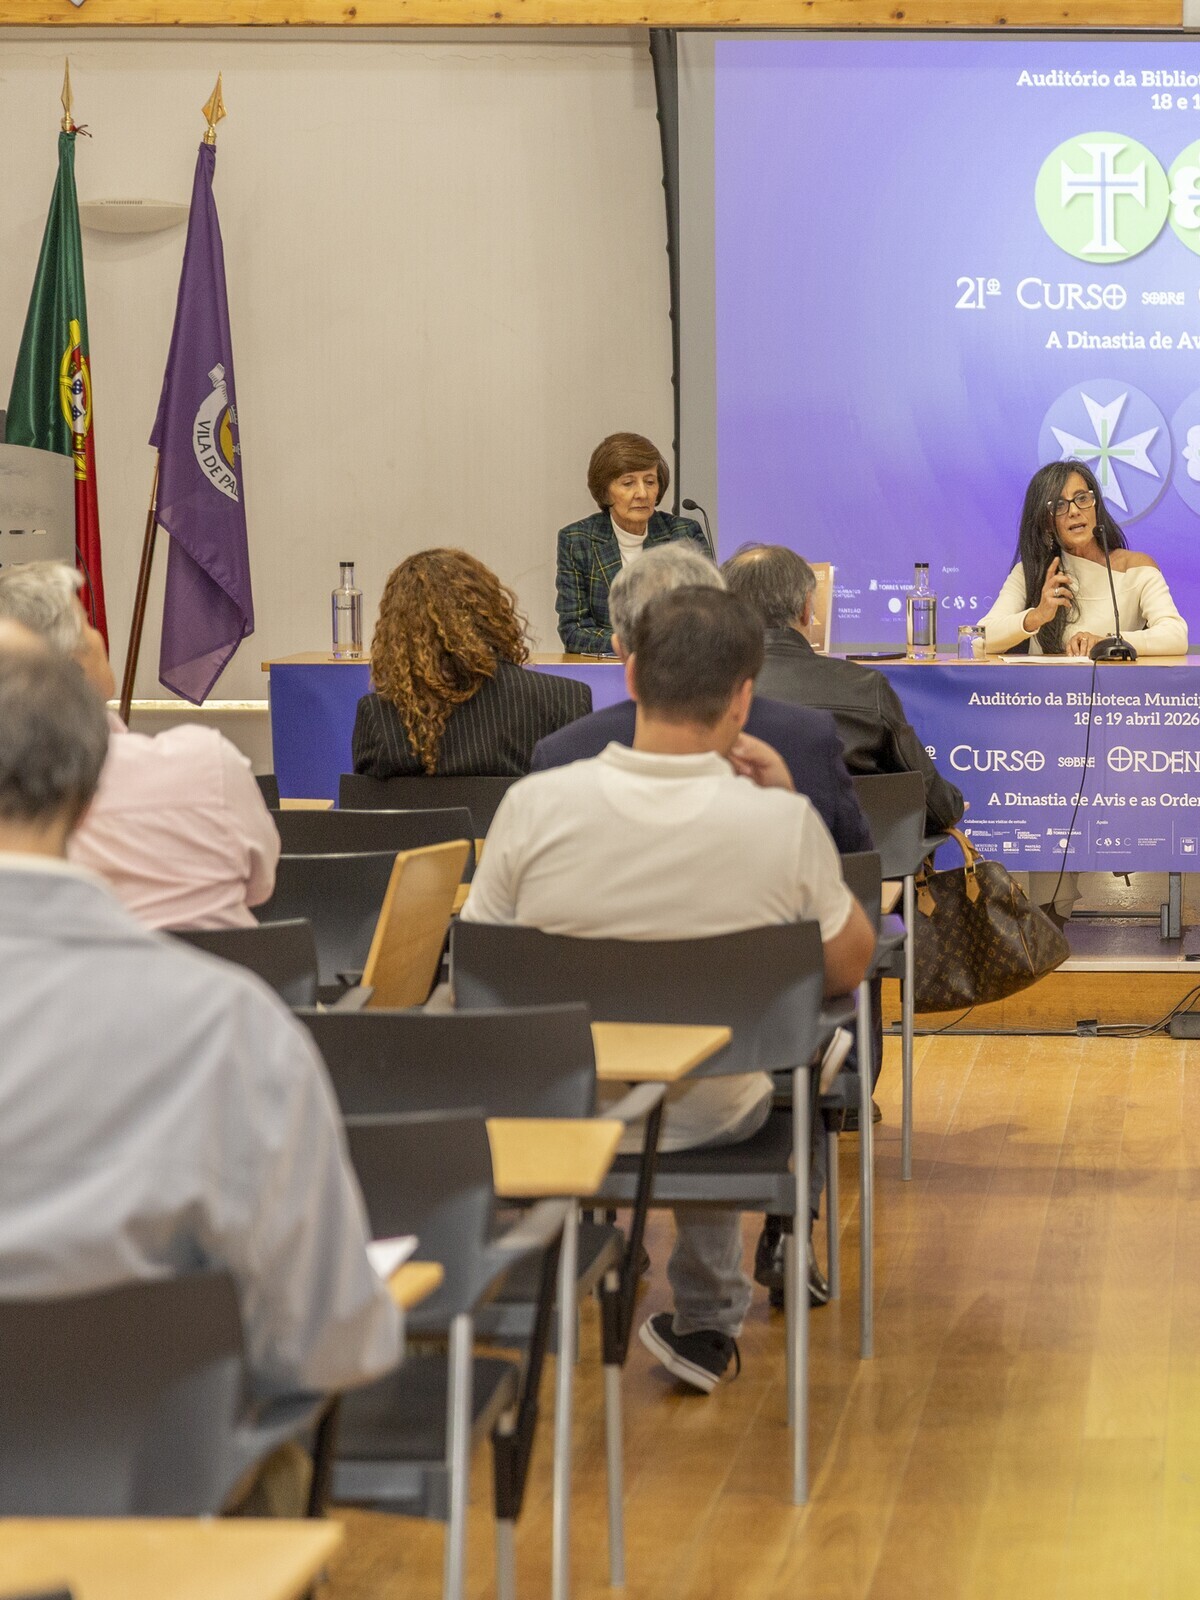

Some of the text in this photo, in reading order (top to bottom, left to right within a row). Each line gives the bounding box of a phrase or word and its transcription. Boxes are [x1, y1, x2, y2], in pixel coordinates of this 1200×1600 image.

[1016, 69, 1111, 87] Auditório
[1113, 69, 1137, 87] da
[1151, 93, 1173, 110] 18
[1176, 97, 1188, 111] e
[1016, 277, 1127, 310] CURSO
[1045, 330, 1063, 349] A
[1066, 330, 1146, 349] Dinastia
[1149, 331, 1173, 350] de
[197, 420, 211, 454] VILA
[203, 455, 222, 477] DE
[967, 691, 1042, 706] Auditório
[1044, 692, 1063, 706] da
[1066, 692, 1142, 706] Biblioteca
[1073, 711, 1200, 727] 18 e 19 abril 2026
[949, 744, 1046, 772] CURSO
[987, 792, 1002, 806] A
[1004, 792, 1068, 807] Dinastia
[1070, 792, 1089, 807] de
[1091, 793, 1126, 807] Avis
[1129, 796, 1138, 807] e
[1140, 796, 1157, 807] as
